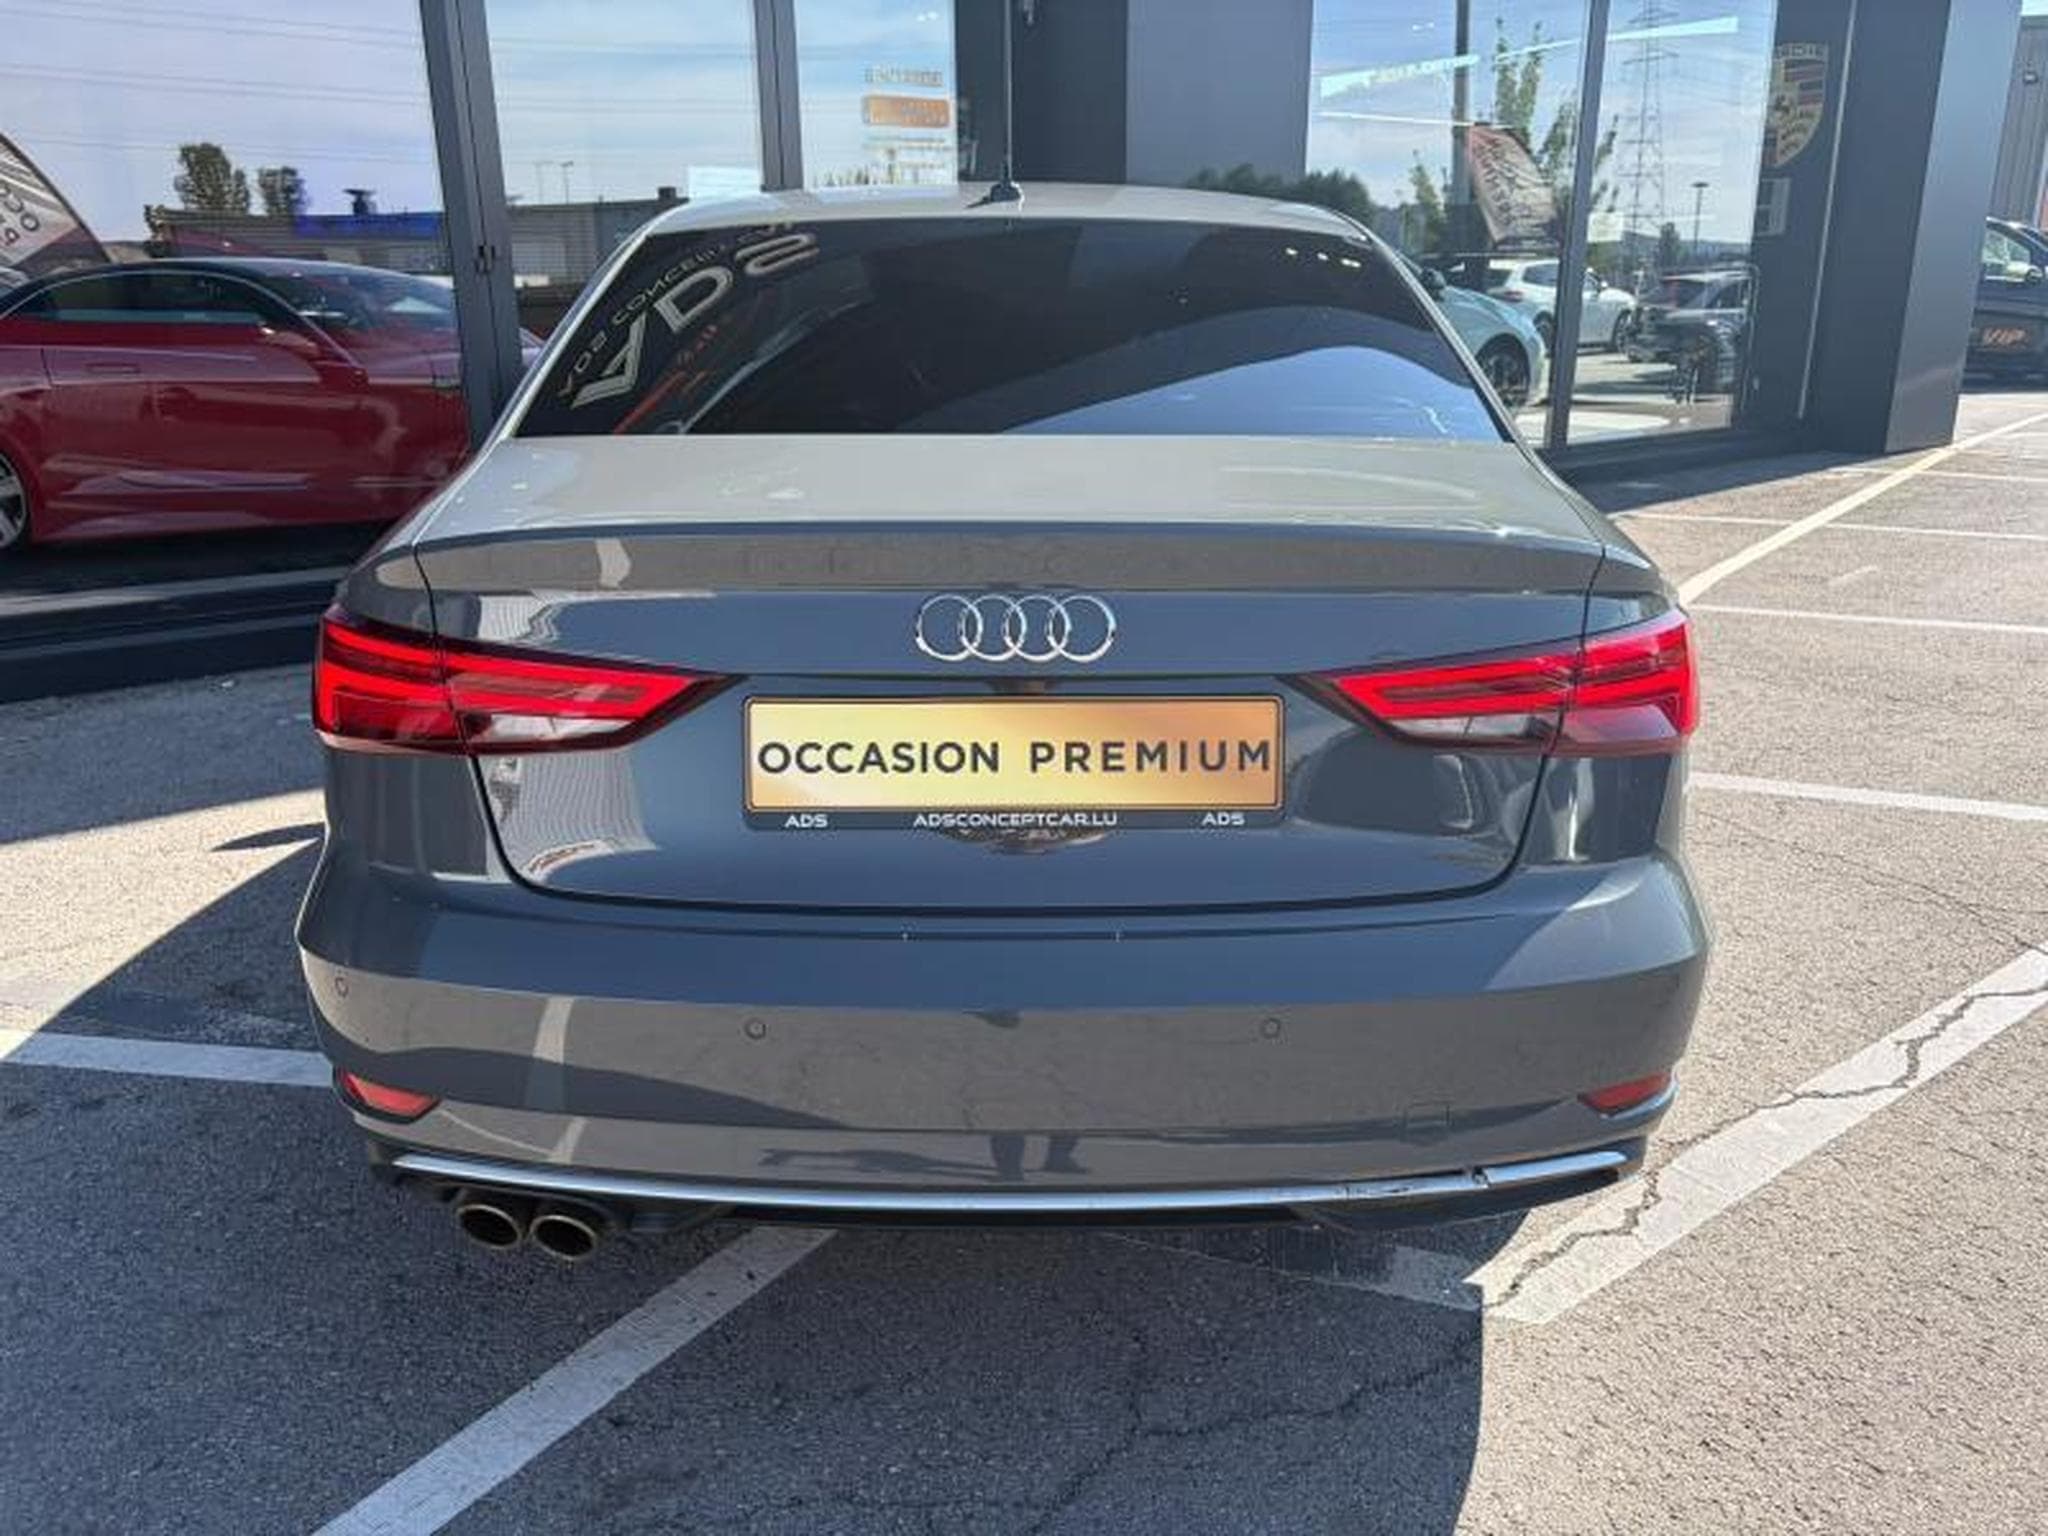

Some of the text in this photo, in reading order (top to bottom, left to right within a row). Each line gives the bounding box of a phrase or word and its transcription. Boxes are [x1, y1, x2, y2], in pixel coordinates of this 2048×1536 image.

[1982, 327, 2027, 344] VIP
[756, 739, 1271, 775] OCCASION PREMIUM
[784, 813, 829, 828] ADS
[913, 812, 1118, 828] ADSCONCEPTCAR.LU
[1202, 811, 1246, 826] ADS
